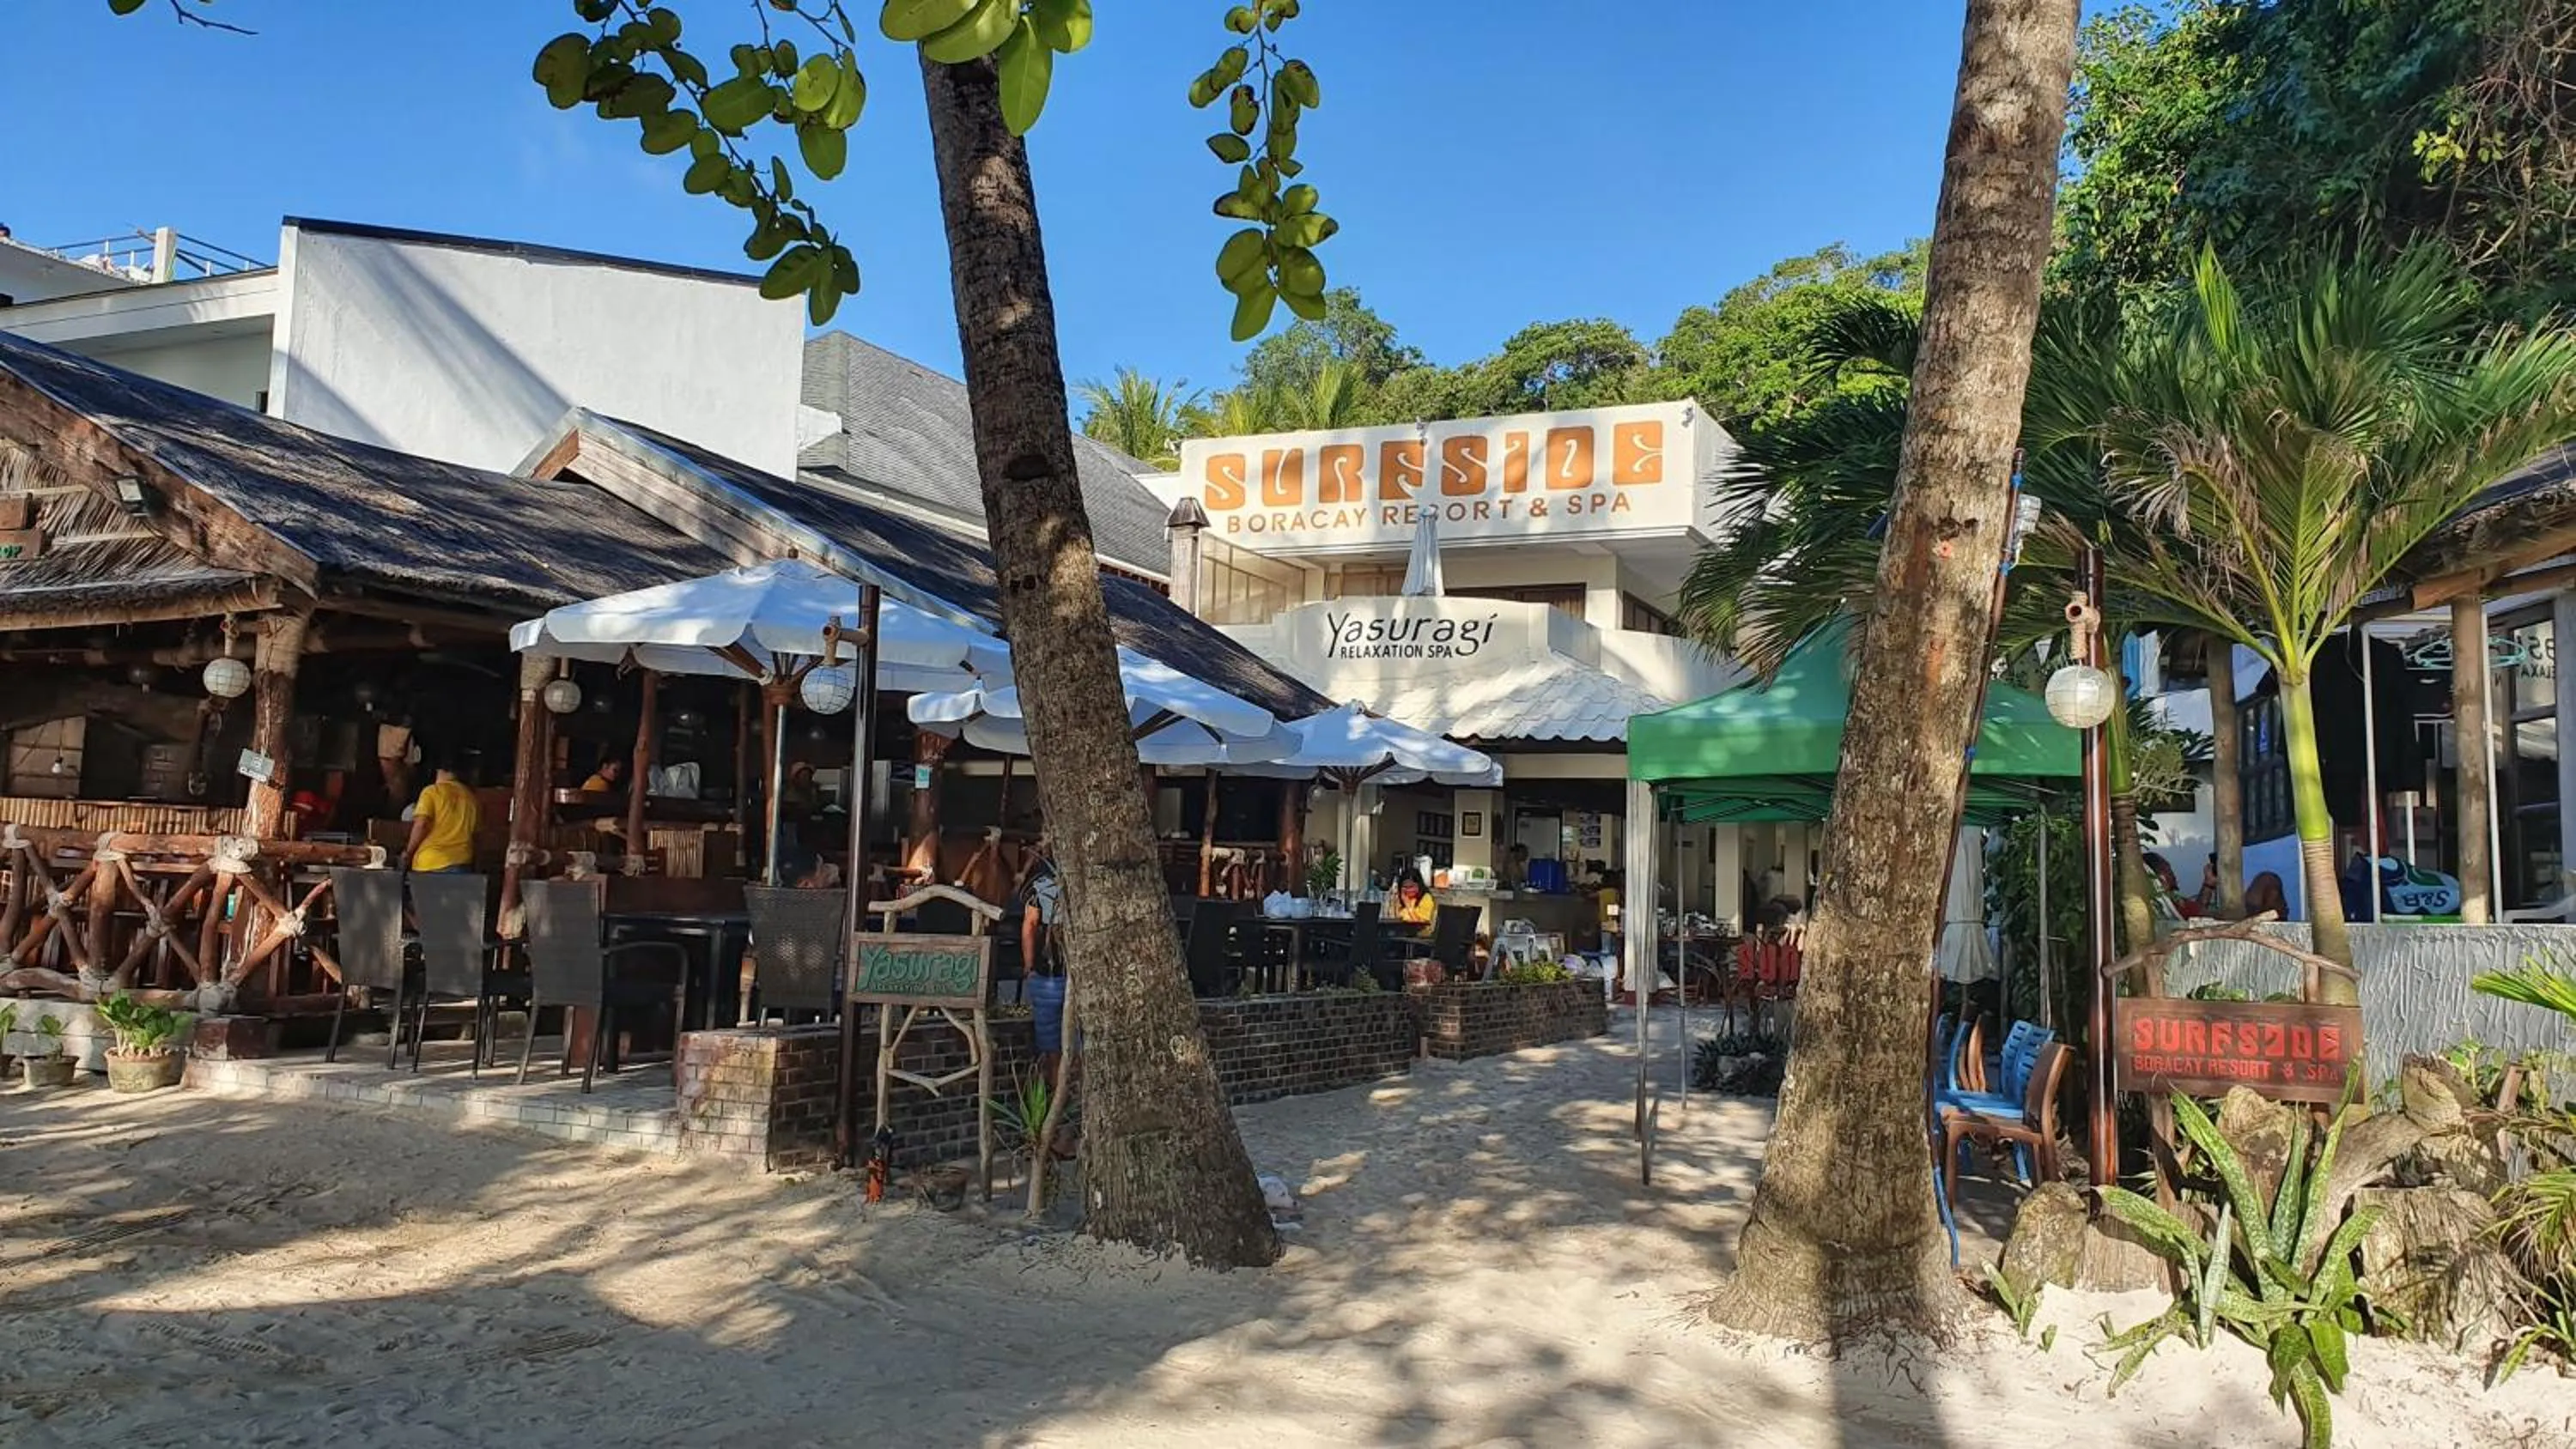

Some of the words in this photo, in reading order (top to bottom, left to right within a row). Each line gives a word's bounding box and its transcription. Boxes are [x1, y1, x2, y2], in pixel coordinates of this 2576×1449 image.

[1205, 420, 1663, 511] SURFSIDE
[1227, 507, 1368, 534] BORACAY
[1529, 497, 1548, 517] &
[1567, 491, 1631, 515] SPA
[1327, 612, 1498, 658] Yasuragi
[1340, 644, 1423, 659] RELAXATION
[1427, 645, 1453, 659] SPA
[857, 943, 980, 992] Yasuragi
[2134, 1016, 2341, 1060] SURFSIDE
[2134, 1055, 2202, 1073] BORACAY
[2208, 1057, 2270, 1080] RESORT
